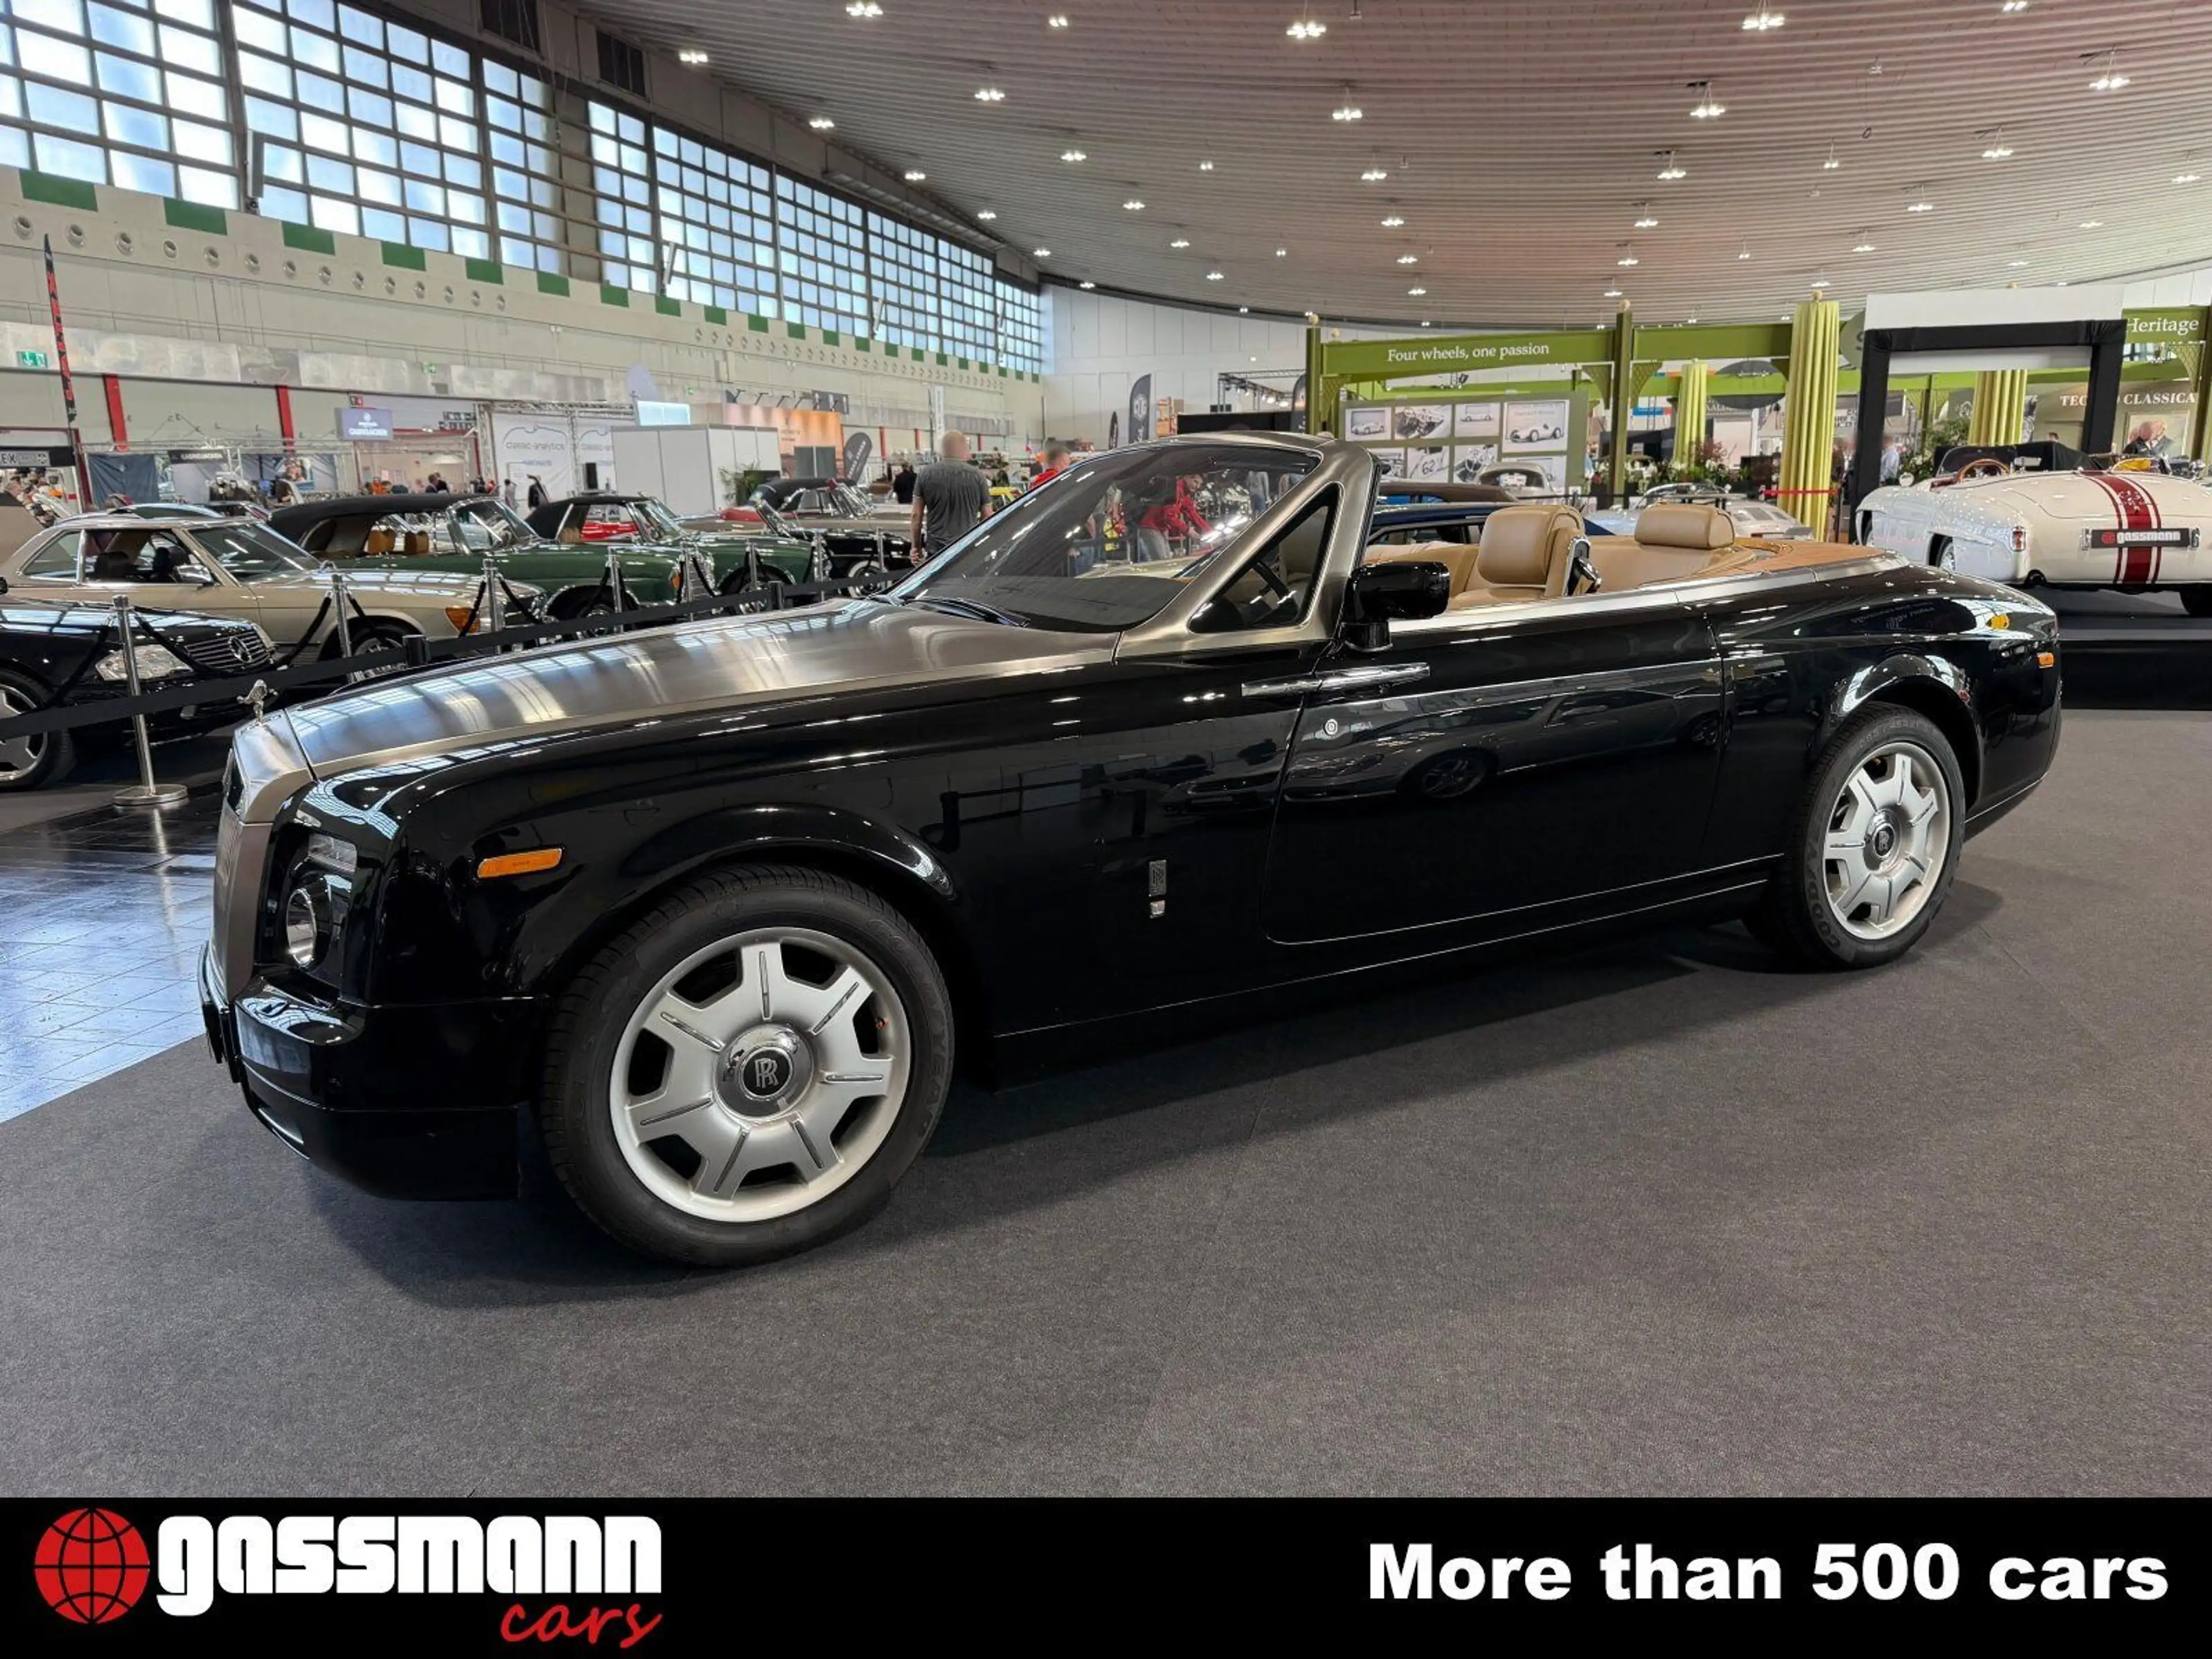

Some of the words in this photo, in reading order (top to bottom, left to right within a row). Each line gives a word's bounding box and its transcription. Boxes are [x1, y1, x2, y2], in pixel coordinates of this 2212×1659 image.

[2127, 317, 2199, 335] Heritage
[1387, 349, 1417, 362] Four
[1421, 346, 1469, 360] wheels,
[1472, 347, 1497, 358] one
[1499, 342, 1550, 360] passion
[2123, 392, 2196, 404] CLASSICA
[1422, 459, 1435, 475] 62
[2117, 531, 2181, 544] gassmann
[753, 1058, 780, 1089] RR
